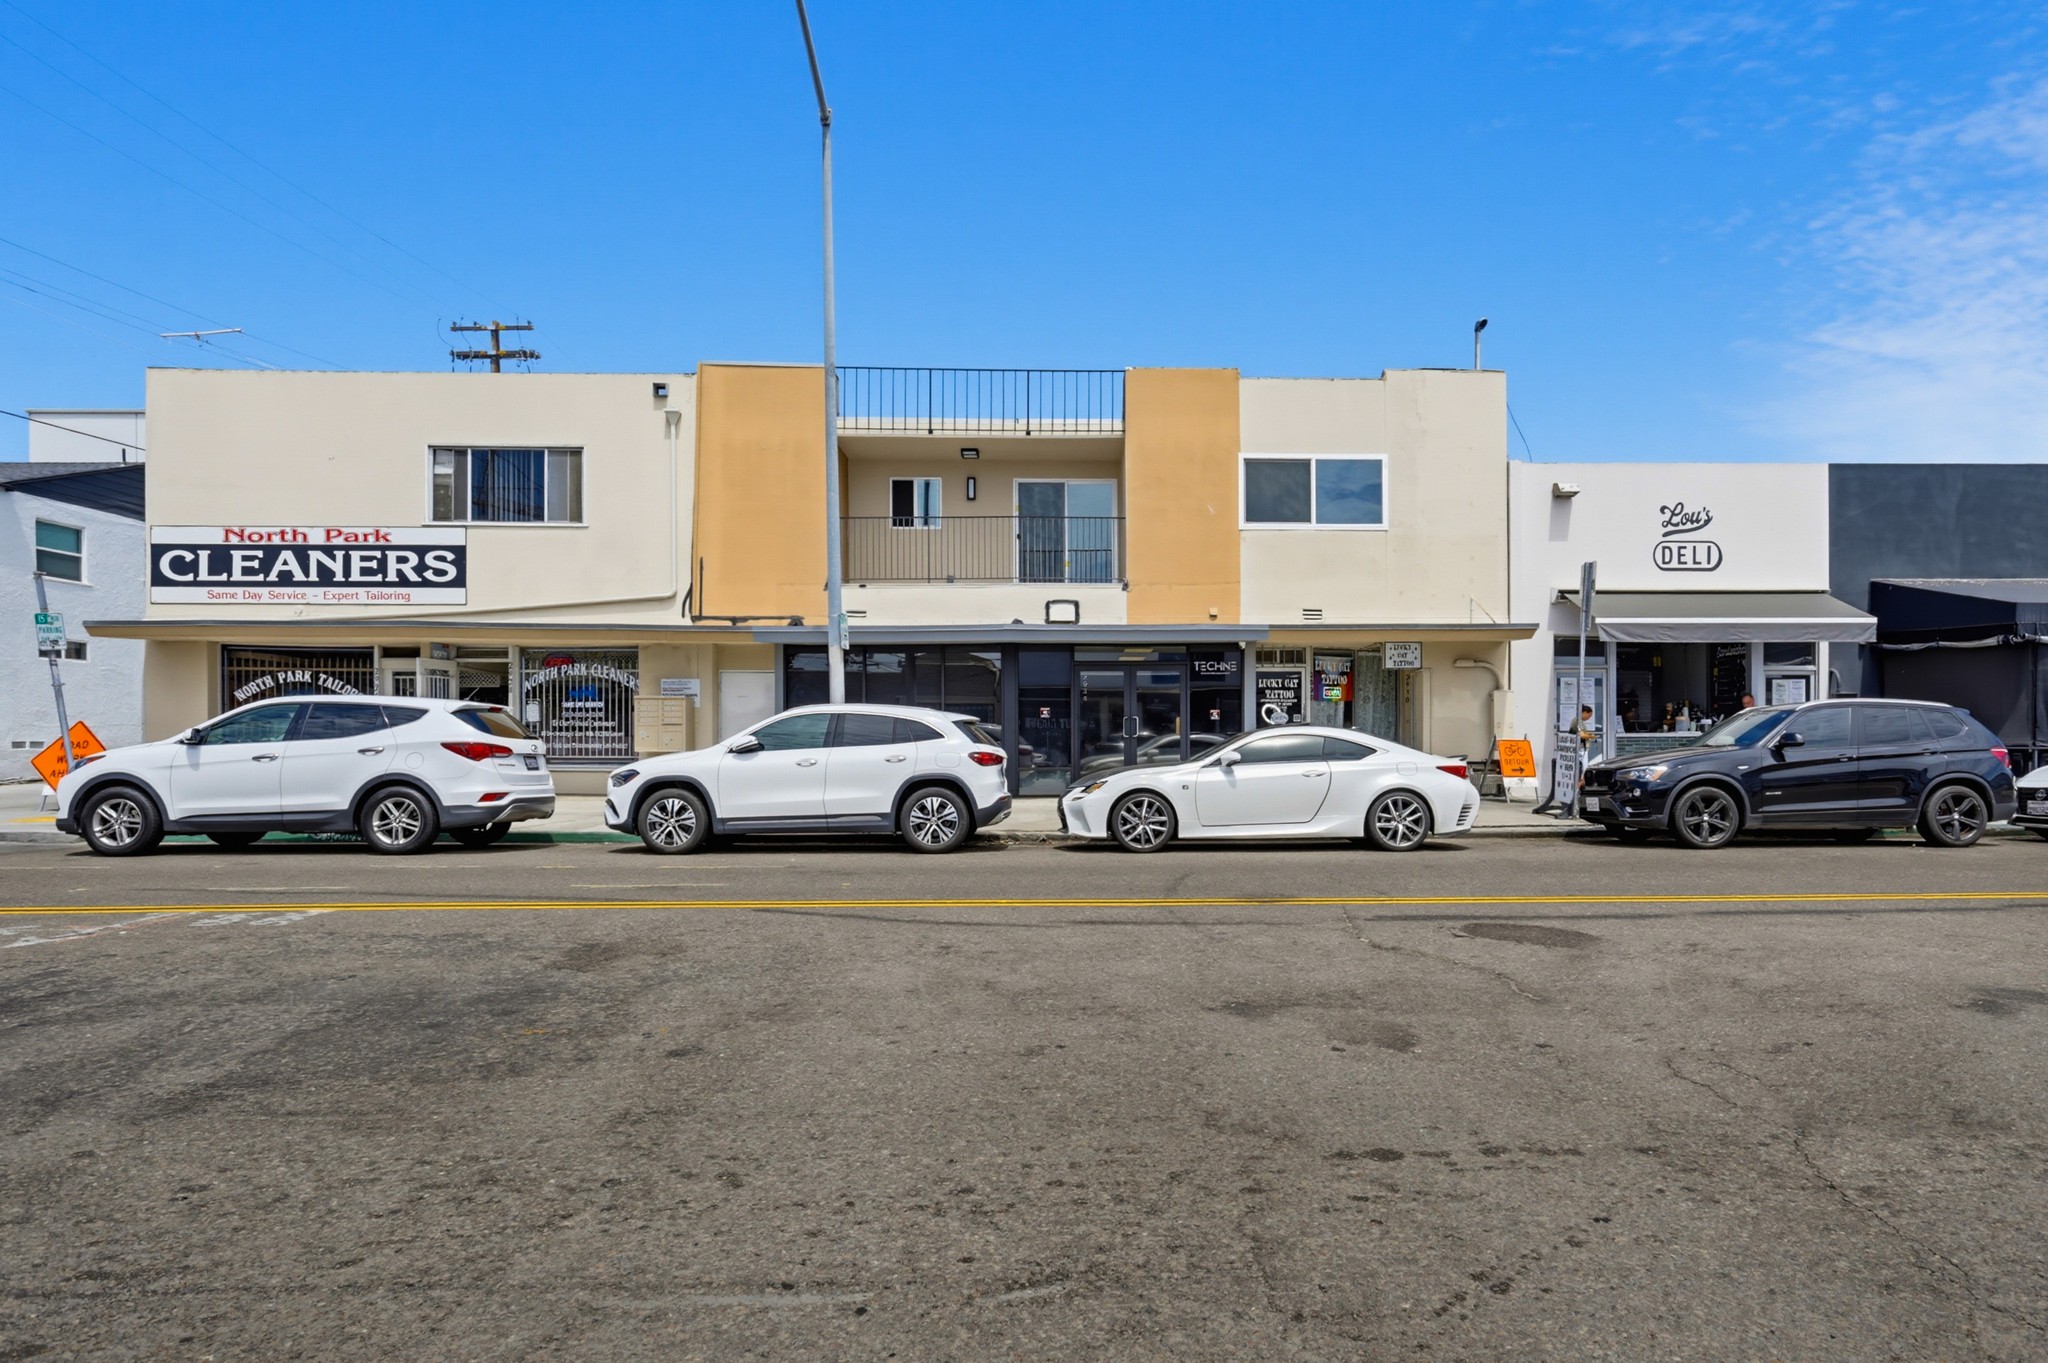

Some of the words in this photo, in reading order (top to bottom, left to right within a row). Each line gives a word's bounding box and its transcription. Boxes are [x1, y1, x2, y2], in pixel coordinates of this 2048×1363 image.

[1660, 502, 1713, 532] Lou's
[222, 527, 309, 543] North
[324, 527, 392, 543] Park
[1662, 545, 1711, 565] DELI
[159, 549, 457, 582] CLEANERS
[207, 590, 238, 600] Same
[243, 590, 263, 601] Day
[268, 590, 307, 600] Service
[323, 591, 359, 602] Expert
[364, 591, 411, 602] Tailoring
[1193, 661, 1237, 671] TECHNE
[234, 674, 275, 702] NORTH
[277, 670, 313, 684] PARK
[317, 673, 365, 695] TAILOR
[524, 666, 558, 693] NORTH
[561, 663, 587, 677] PARK
[1258, 679, 1282, 688] LUCKY
[1284, 679, 1299, 688] CAT
[1265, 690, 1294, 699] TATTOO
[1504, 758, 1530, 766] DETOUR
